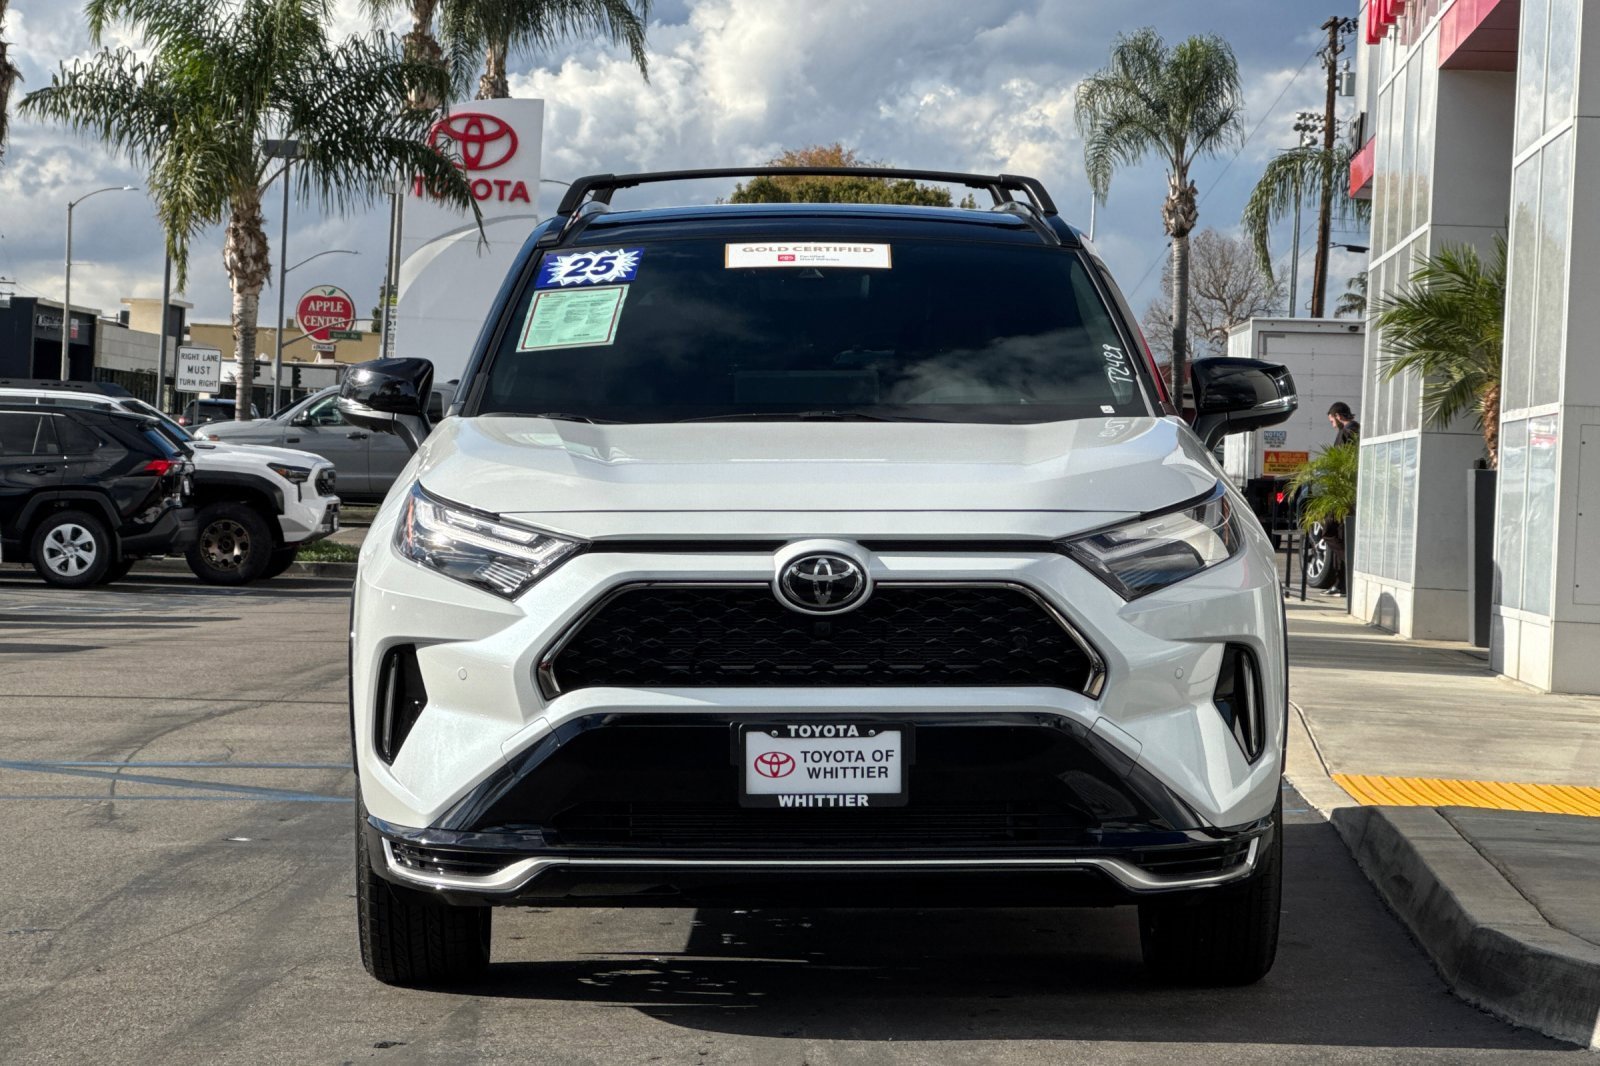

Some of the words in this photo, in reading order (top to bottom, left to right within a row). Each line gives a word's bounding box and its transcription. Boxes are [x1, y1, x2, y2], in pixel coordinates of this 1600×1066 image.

[563, 255, 618, 278] 25
[308, 300, 344, 313] APPLE
[303, 315, 345, 328] CENTER
[180, 352, 200, 361] RIGHT
[202, 354, 219, 362] LANE
[187, 365, 211, 375] MUST
[179, 377, 196, 387] TURN
[198, 379, 218, 388] RIGHT
[787, 725, 859, 738] TOYOTA
[800, 750, 866, 763] TOYOTA
[871, 750, 895, 762] OF
[807, 766, 889, 779] WHITTIER
[778, 794, 869, 807] WHITTIER
